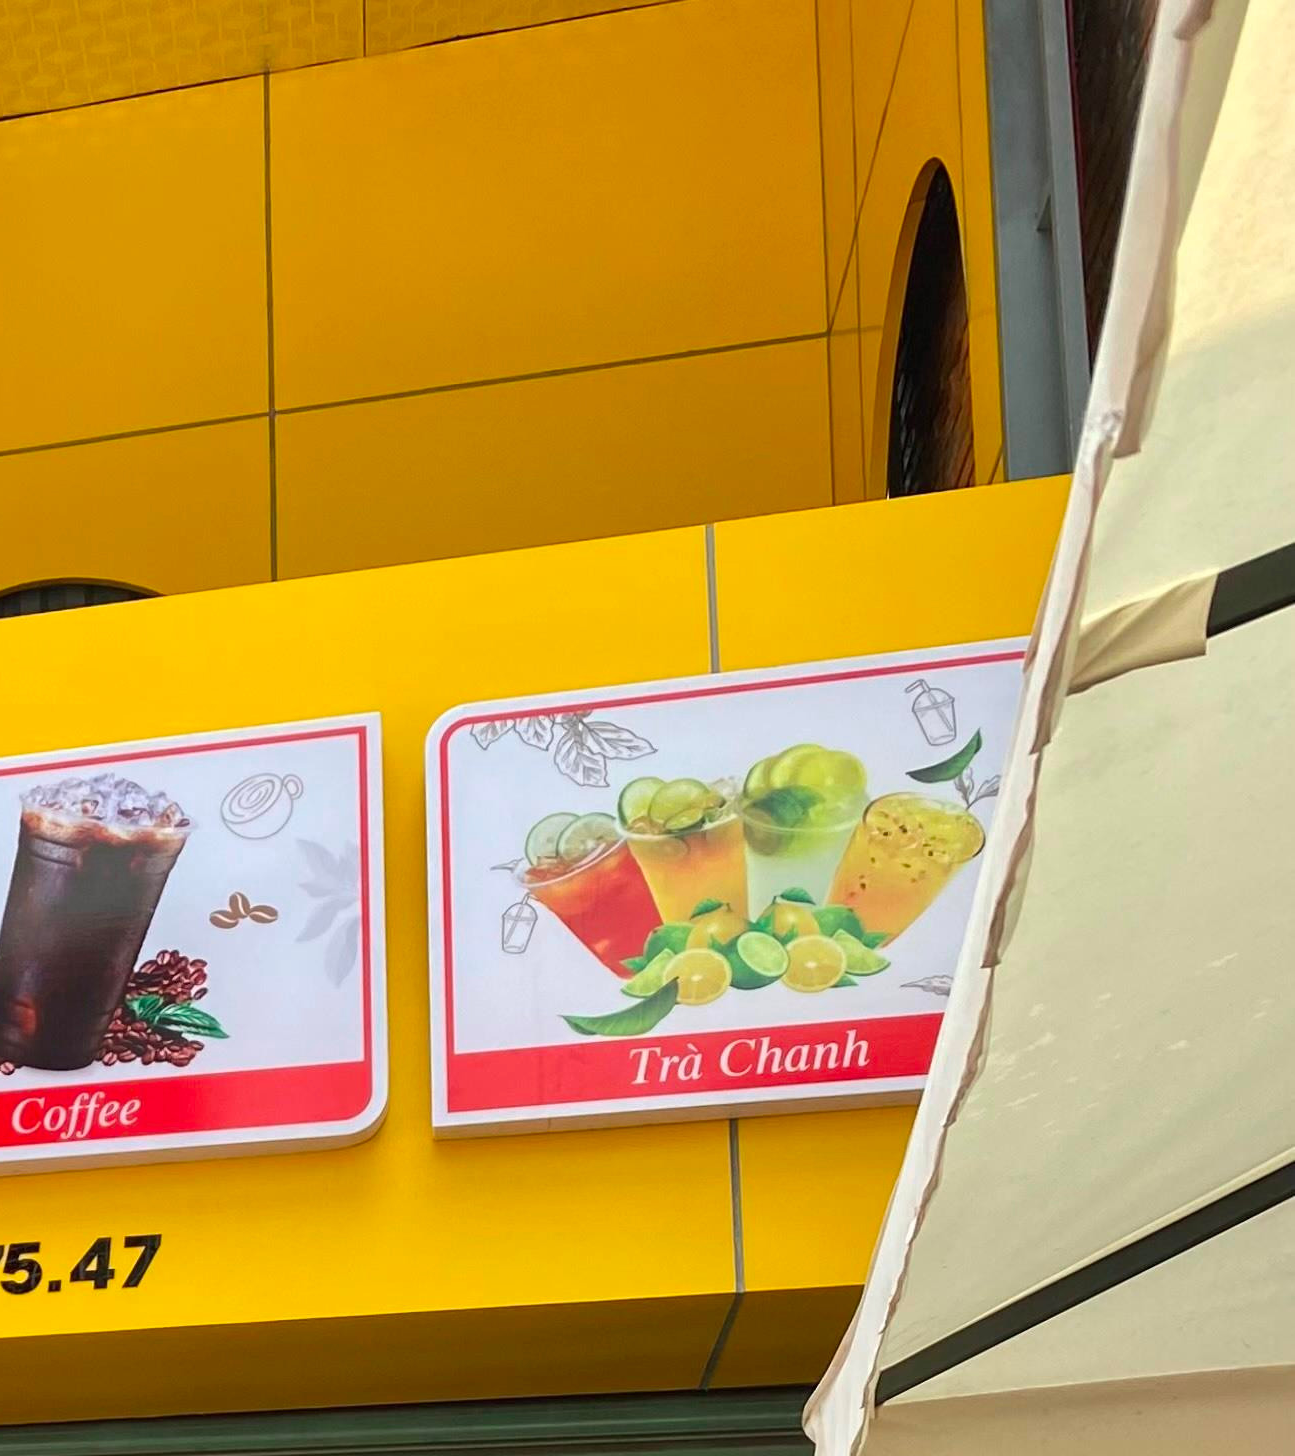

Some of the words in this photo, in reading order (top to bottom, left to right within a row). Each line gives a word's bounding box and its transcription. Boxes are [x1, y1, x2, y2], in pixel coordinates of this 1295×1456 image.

[628, 1042, 703, 1085] Trà
[719, 1029, 870, 1077] Chanh
[11, 1091, 141, 1140] Coffee
